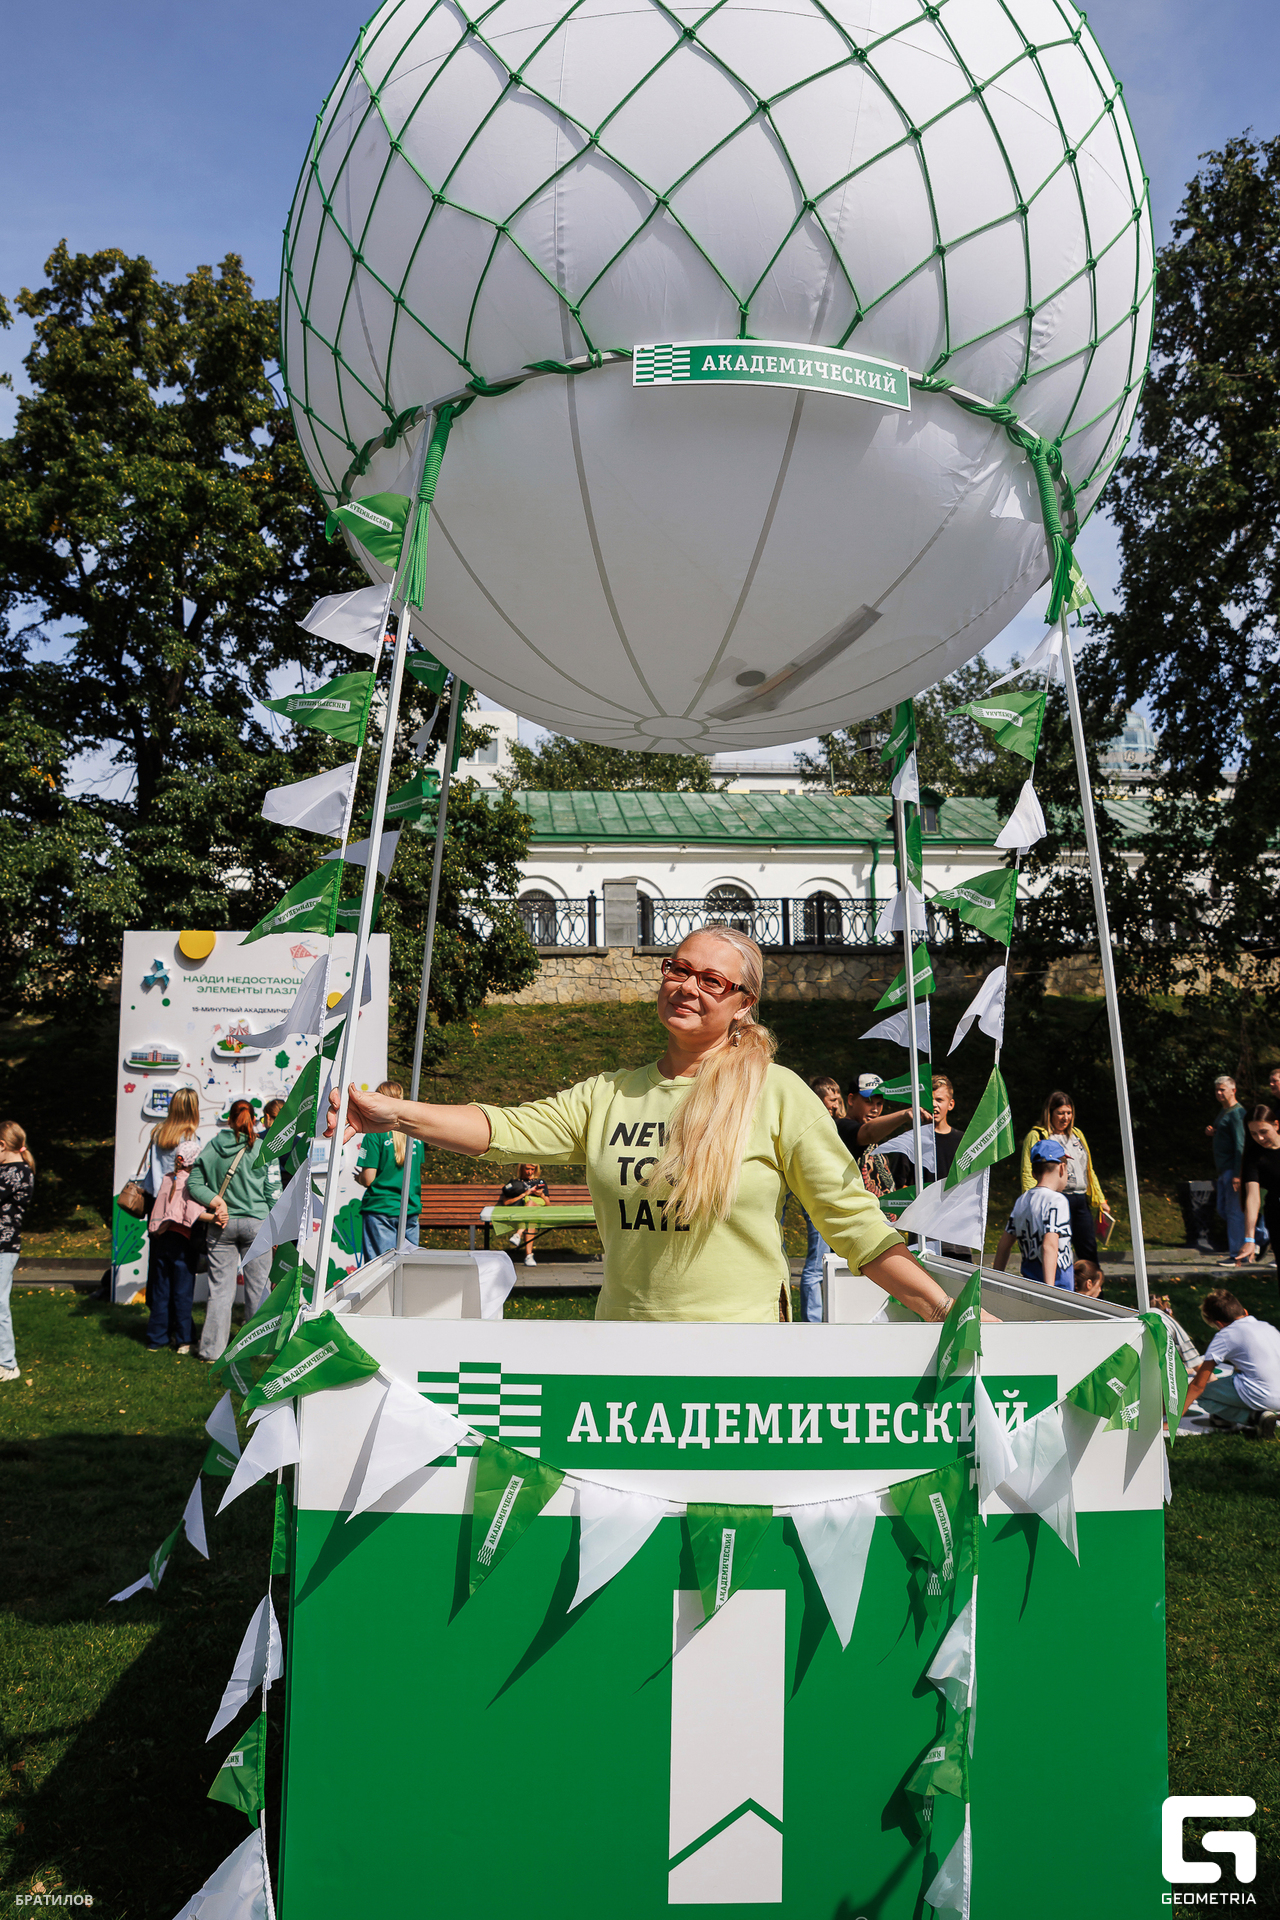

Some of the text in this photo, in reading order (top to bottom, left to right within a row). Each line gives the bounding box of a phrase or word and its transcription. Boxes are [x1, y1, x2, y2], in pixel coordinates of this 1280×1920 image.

[701, 355, 897, 394] АКАДЕМИЧЕСКИЙ
[183, 974, 224, 984] НАЙДИ
[196, 986, 297, 995] ЭЛЕМЕНТЫ ПАЗЛ
[617, 1156, 680, 1188] TO
[282, 1344, 335, 1385] АКАДЕМИЧЕСКИЙ
[488, 1480, 520, 1545] АКАДЕМИЧЕСКИЙ
[720, 1533, 732, 1601] АКАДЕМИЧЕСКИЙ
